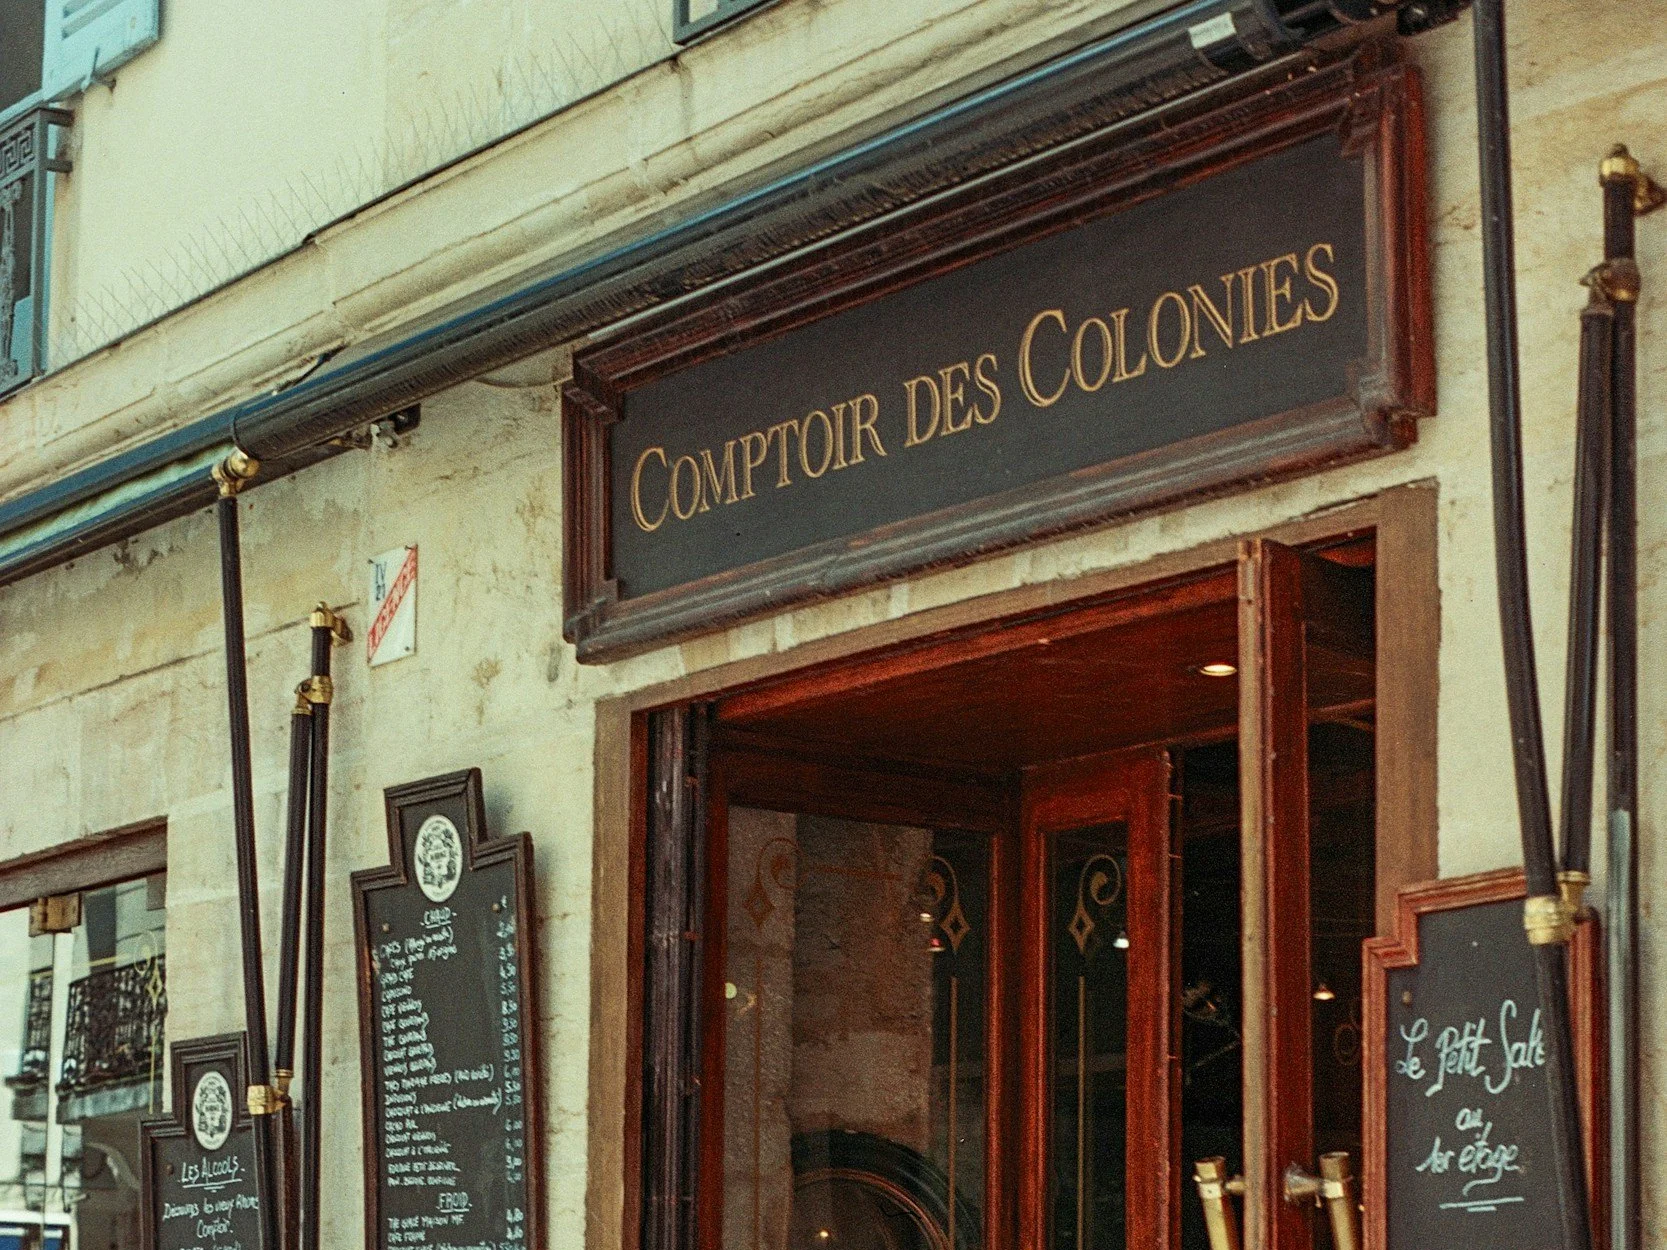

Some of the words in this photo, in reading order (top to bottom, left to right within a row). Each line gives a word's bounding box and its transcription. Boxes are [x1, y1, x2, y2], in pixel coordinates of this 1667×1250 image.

[629, 393, 887, 533] COMPTOIR
[903, 353, 1000, 449] DES
[1019, 243, 1340, 408] COLONIES
[1455, 1107, 1484, 1131] au
[181, 1162, 199, 1184] LES
[201, 1155, 239, 1185] ALCOOLS
